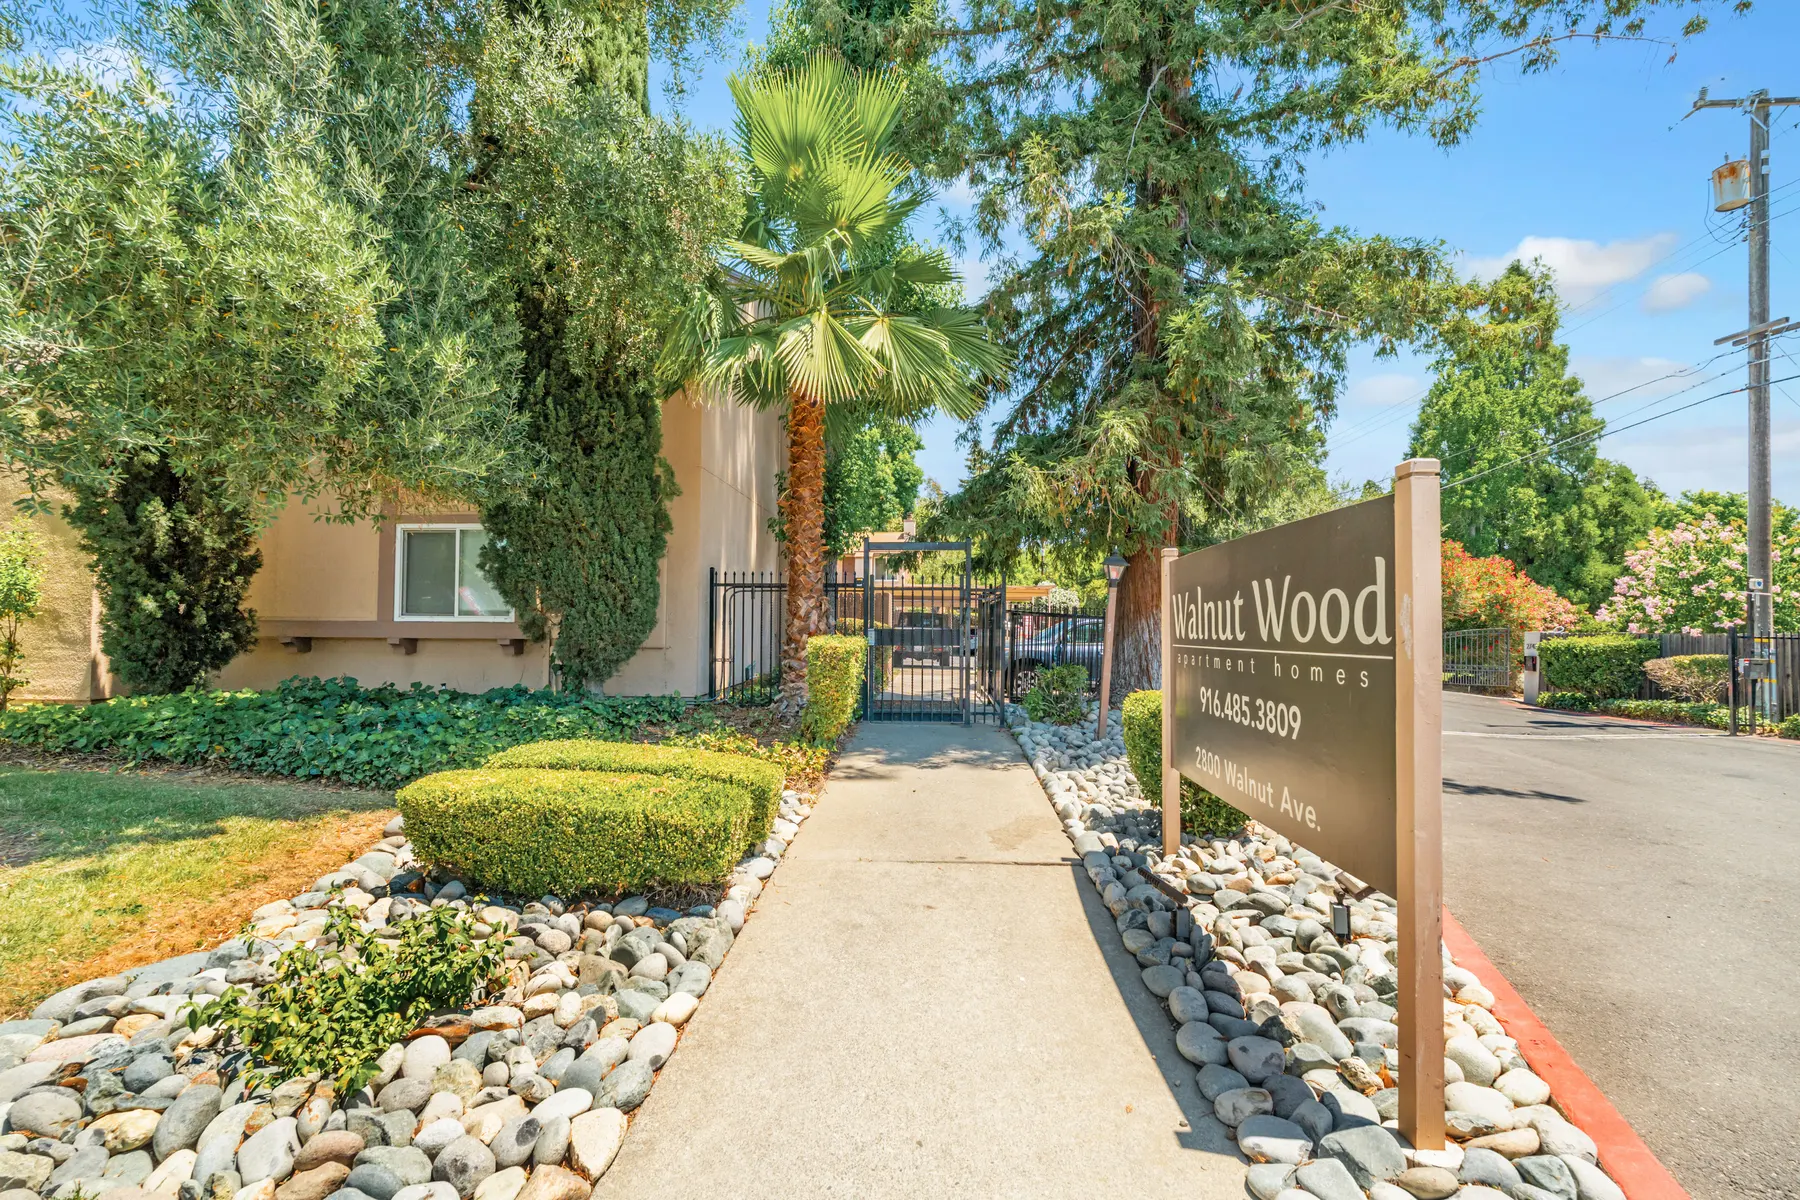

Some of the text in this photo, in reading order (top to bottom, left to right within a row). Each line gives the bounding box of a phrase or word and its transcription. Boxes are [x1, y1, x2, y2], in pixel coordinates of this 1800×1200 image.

[1172, 556, 1392, 645] Walnut Wood
[1177, 653, 1369, 688] apartment homes
[1200, 686, 1301, 740] 916.485.3809
[1195, 746, 1321, 832] 2800 Walnut Ave.
